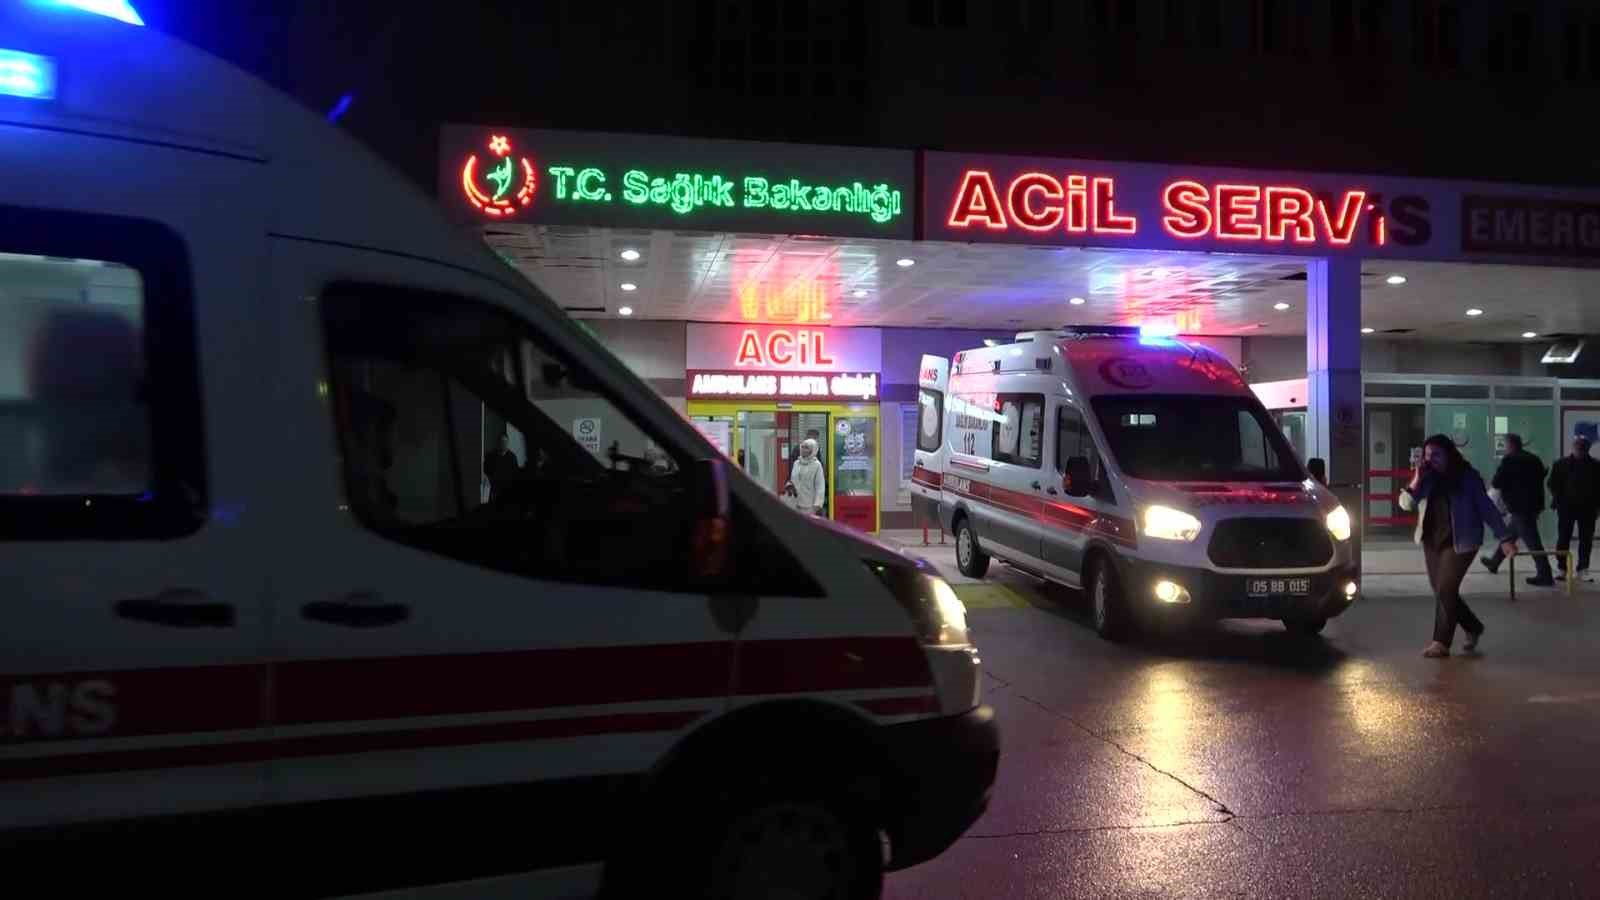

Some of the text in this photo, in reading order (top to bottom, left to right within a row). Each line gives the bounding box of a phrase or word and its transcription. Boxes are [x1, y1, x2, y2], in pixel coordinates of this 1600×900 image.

[548, 166, 901, 223] T.C. Sağlık Bakanlığı
[1253, 580, 1268, 594] 05
